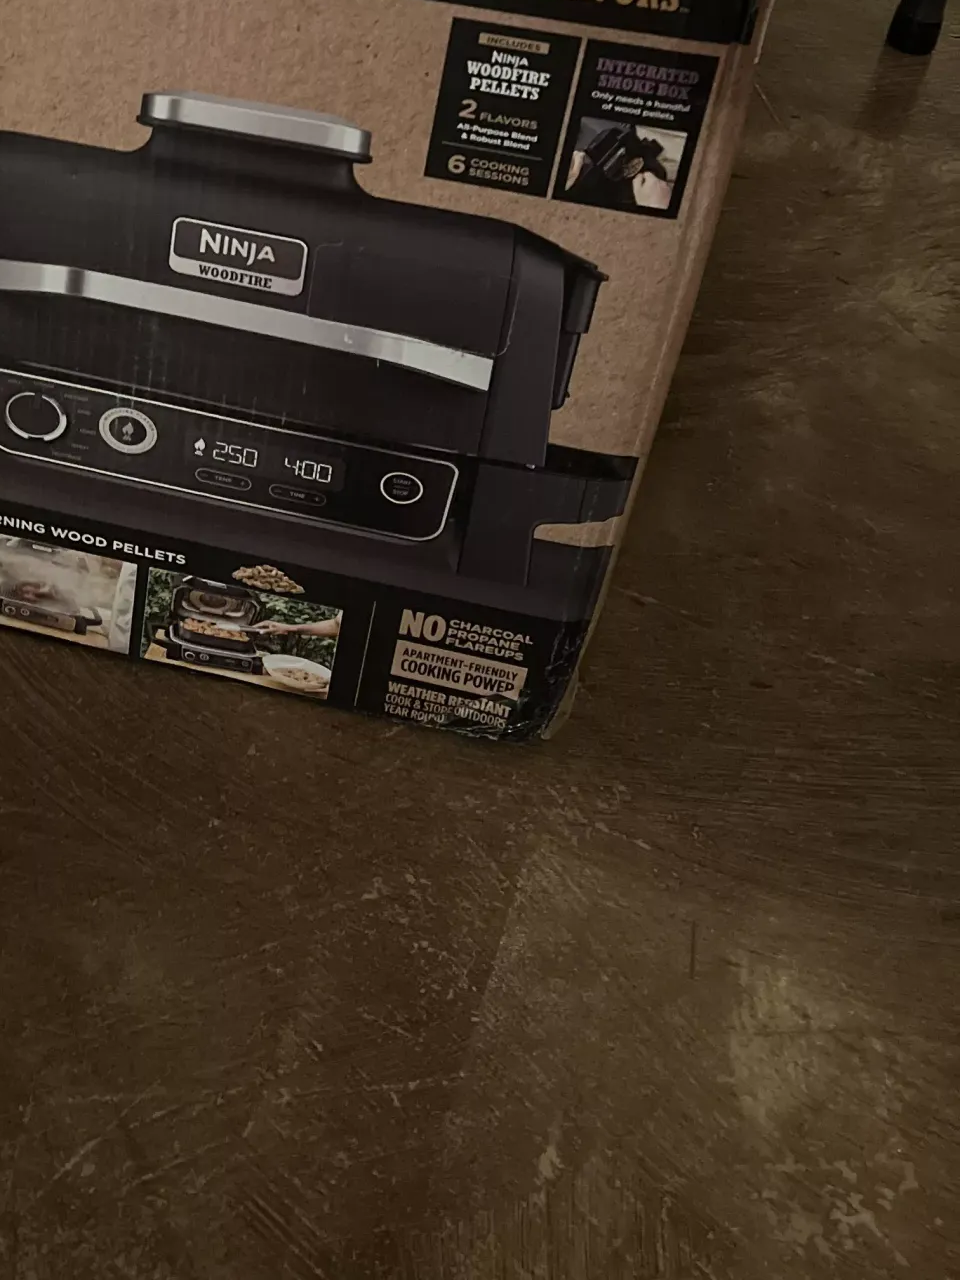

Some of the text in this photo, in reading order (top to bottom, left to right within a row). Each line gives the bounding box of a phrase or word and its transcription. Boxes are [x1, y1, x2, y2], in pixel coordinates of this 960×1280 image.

[487, 36, 541, 52] INCLUDES
[491, 50, 529, 68] NINJA
[596, 57, 700, 84] INTEGRATED
[467, 60, 551, 87] WOODFIRE
[469, 77, 540, 100] PELLETS
[592, 90, 614, 102] Only
[598, 75, 692, 100] SMOKE BOX
[458, 98, 538, 130] 2 FLAVORS
[602, 103, 675, 121] of wood pellets
[447, 154, 466, 174] 6
[470, 158, 530, 176] COOKING
[468, 168, 529, 186] SESSIONS
[199, 228, 275, 266] NINJA
[199, 265, 272, 289] WOODFIRE
[213, 441, 258, 468] 250
[51, 526, 108, 548] WOOD
[113, 540, 187, 565] PELLETS
[399, 608, 446, 642] NO
[449, 619, 534, 645] CHARCOAL
[445, 637, 524, 661] FLAREUPS
[448, 628, 520, 650] PROPANE
[401, 659, 515, 693] COOKING POWER
[403, 648, 518, 681] APARTMENT-FRIENDLY
[388, 681, 446, 706] WEATHER
[384, 704, 410, 718] YEAR
[385, 693, 412, 708] COOK
[414, 701, 421, 710] &
[454, 706, 507, 729] OUTDOORS
